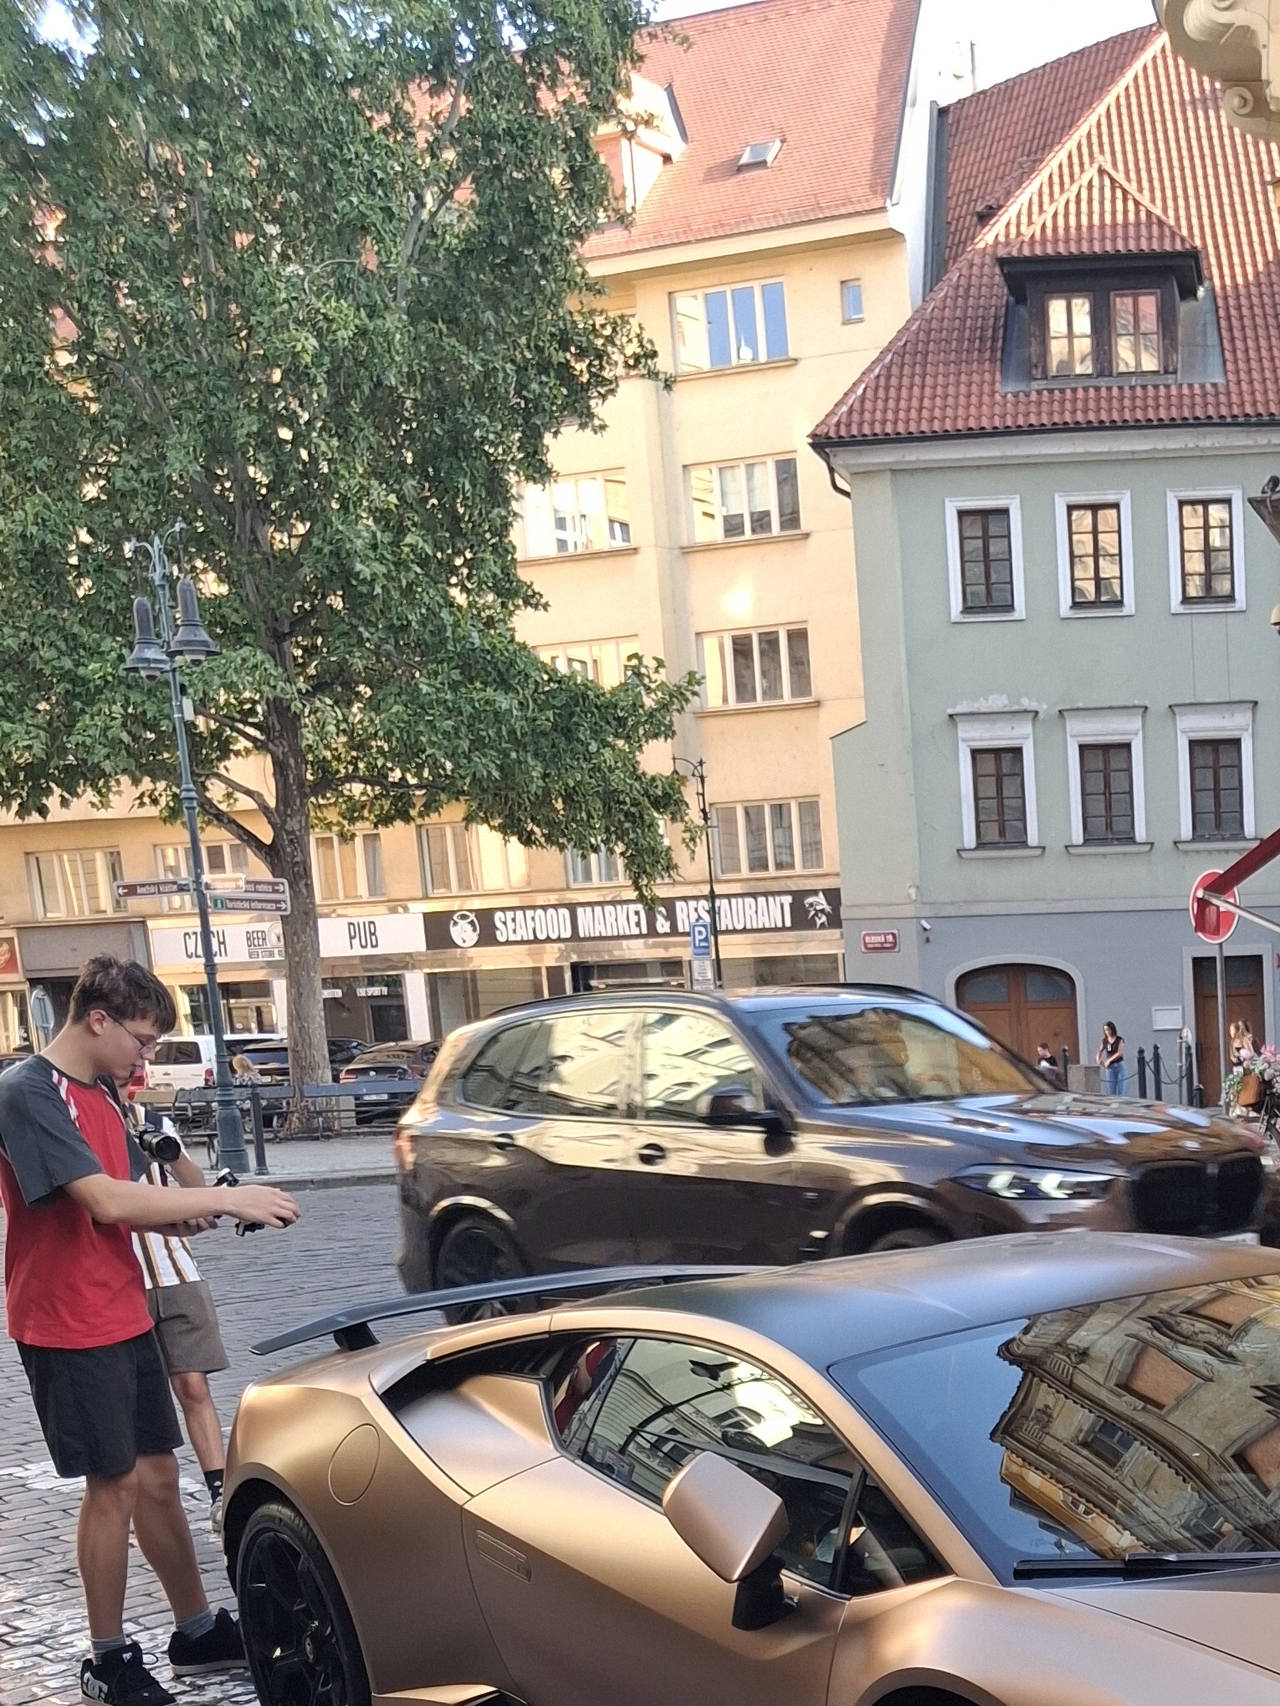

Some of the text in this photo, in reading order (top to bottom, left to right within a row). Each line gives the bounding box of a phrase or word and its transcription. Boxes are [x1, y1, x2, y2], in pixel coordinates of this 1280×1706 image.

[347, 920, 379, 951] PUB
[494, 907, 573, 942] SEAFOOD
[577, 903, 649, 938] MARKET
[655, 907, 671, 934] &
[694, 926, 707, 947] P
[183, 929, 228, 959] CZCH
[246, 930, 268, 947] BEER
